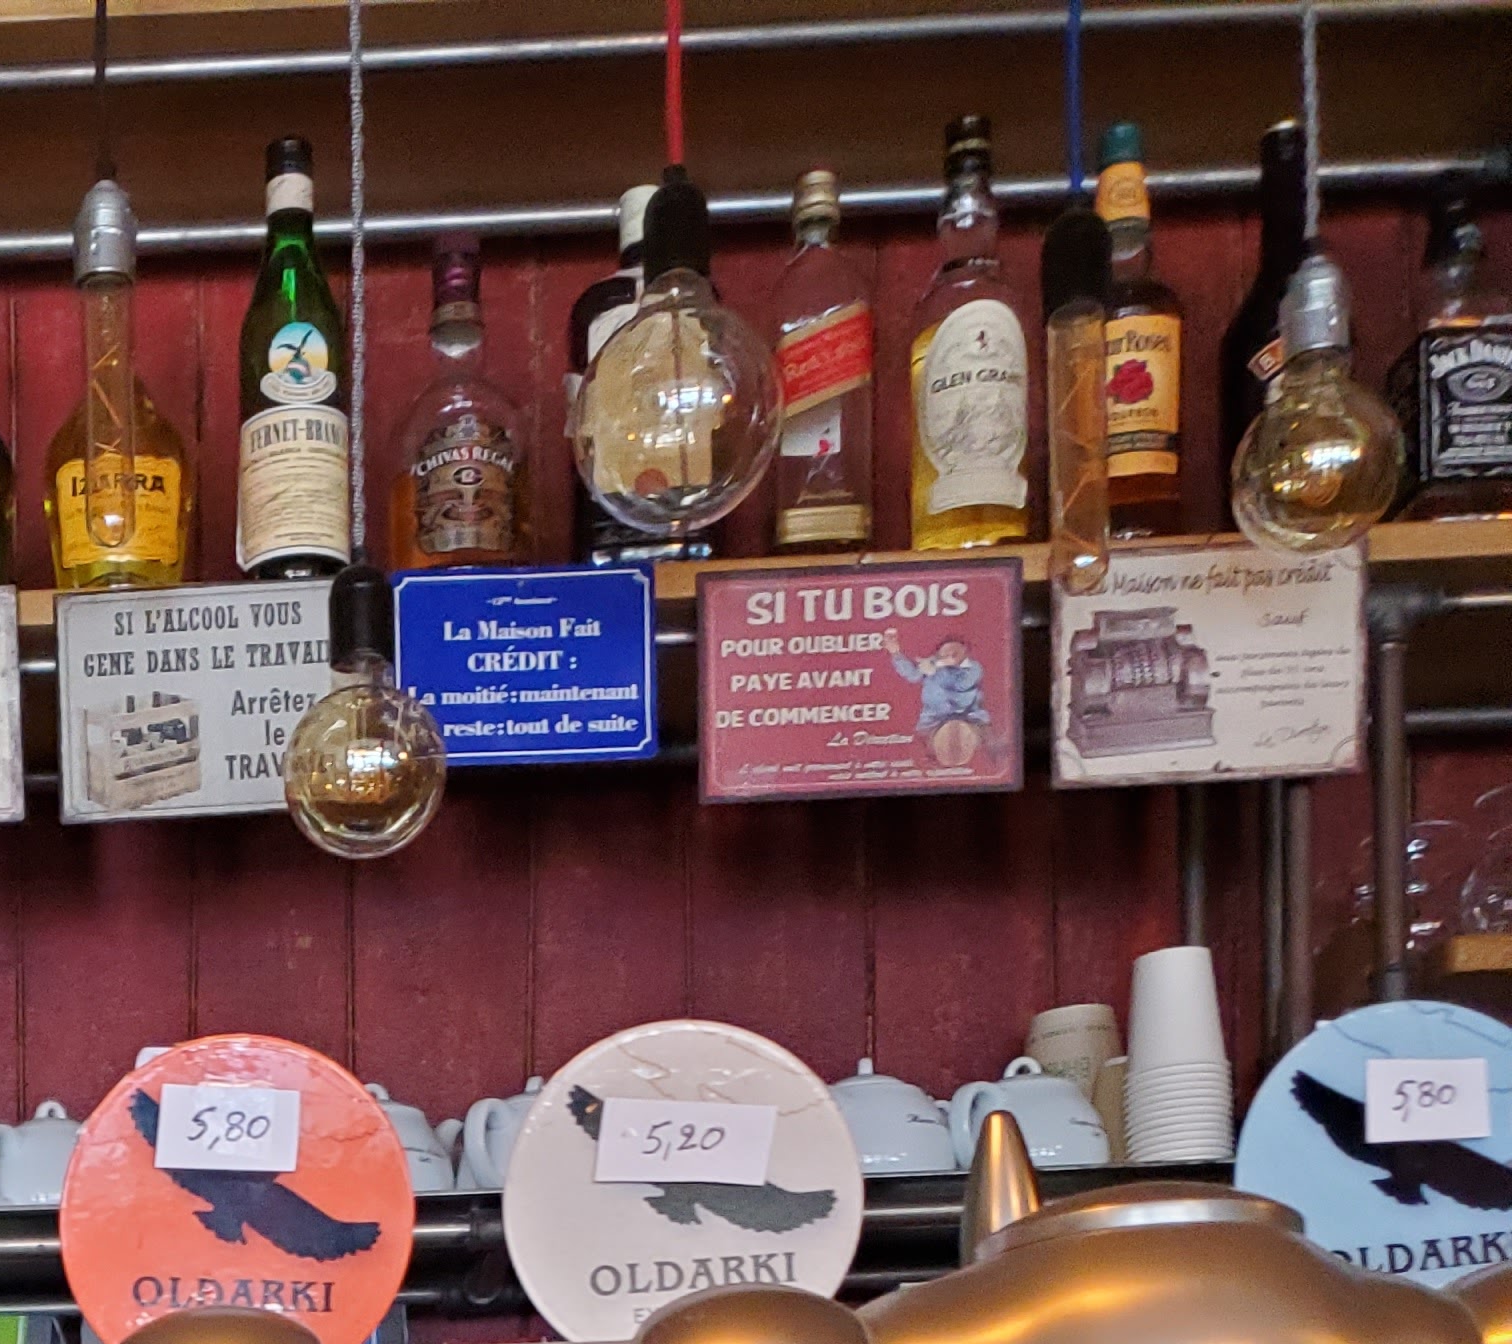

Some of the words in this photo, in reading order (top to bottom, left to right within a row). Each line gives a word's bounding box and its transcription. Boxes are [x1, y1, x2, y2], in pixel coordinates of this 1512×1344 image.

[416, 447, 469, 476] CHIVAS
[114, 611, 133, 636] SI
[145, 605, 239, 634] L'ALCOOL
[250, 601, 302, 628] VOUS
[746, 590, 786, 626] SI
[796, 588, 853, 623] TU
[863, 582, 969, 620] BOIS
[443, 621, 472, 641] La
[477, 619, 554, 641] Maison
[559, 617, 602, 638] Fait
[467, 645, 564, 673] CRÉDIT
[720, 637, 785, 658] POUR
[787, 631, 886, 656] OUBLIER
[84, 651, 135, 677] GENE
[147, 647, 200, 674] DANS
[211, 645, 236, 670] LE
[730, 672, 793, 693] PAYE
[796, 667, 874, 690] AVANT
[555, 713, 583, 735] de
[587, 713, 639, 734] suite
[715, 710, 745, 729] DE
[748, 702, 893, 727] COMMENCER
[265, 719, 286, 746] le
[186, 1105, 271, 1150] 5,80
[641, 1120, 726, 1162] 5,20
[1331, 1230, 1512, 1275] LDARK
[589, 1251, 798, 1298] OLDARKI
